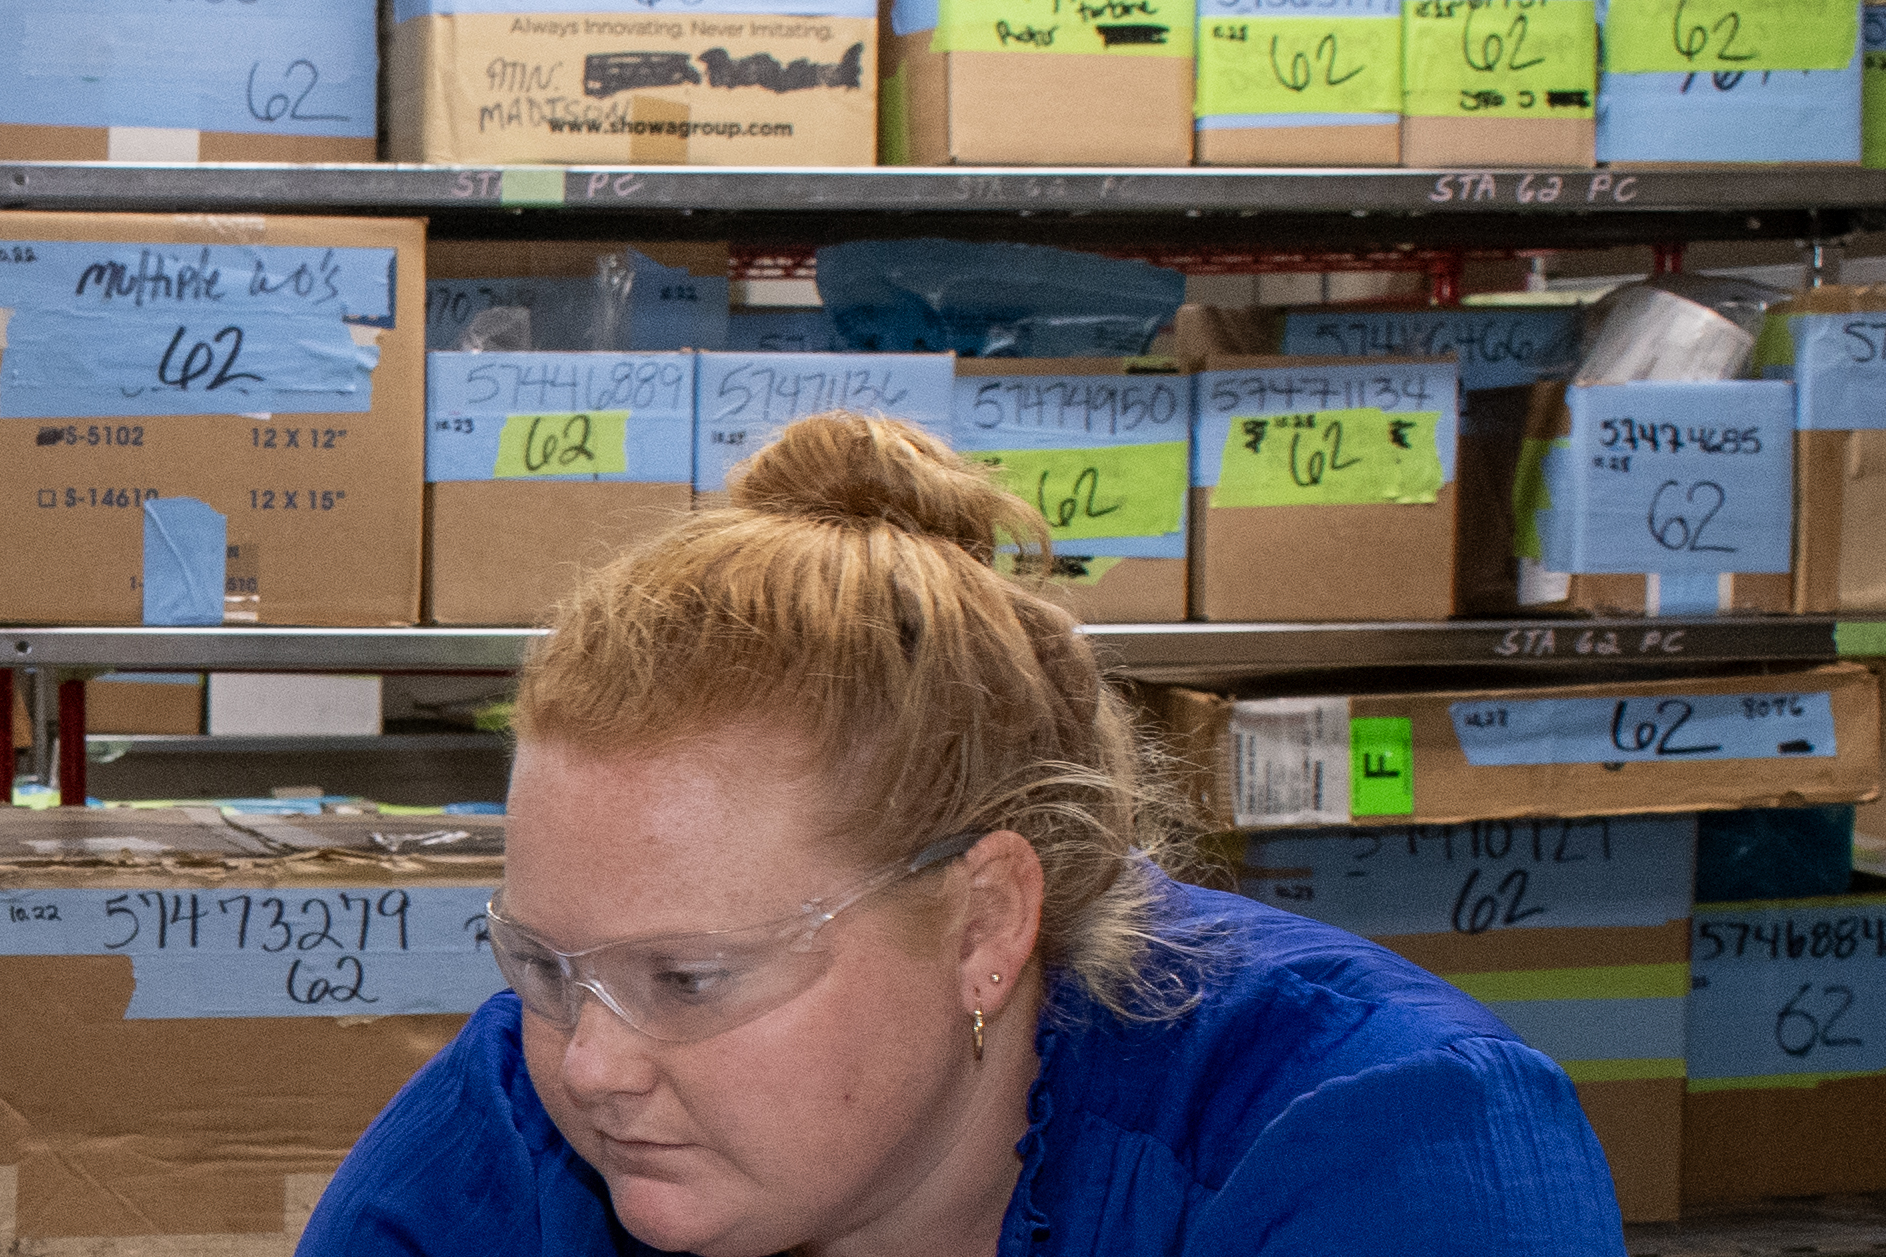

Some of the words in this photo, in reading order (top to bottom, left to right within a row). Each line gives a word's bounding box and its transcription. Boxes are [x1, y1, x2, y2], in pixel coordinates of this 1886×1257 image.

[510, 19, 579, 38] Always
[584, 20, 684, 39] Innovating.
[691, 22, 745, 38] Never
[751, 23, 834, 41] Imitating.
[1464, 8, 1546, 72] 62
[1673, 0, 1759, 62] 62
[246, 58, 350, 122] 62
[1269, 33, 1366, 91] 62
[547, 116, 794, 139] www.showagroup.com
[1431, 176, 1498, 202] STA
[1589, 177, 1639, 201] PC
[158, 326, 265, 391] 62
[252, 427, 279, 449] 12
[525, 413, 596, 472] 62
[1289, 420, 1362, 487] 62
[250, 489, 277, 511] 12
[1038, 466, 1127, 528] 62
[1646, 479, 1737, 552] 62
[1493, 630, 1557, 657] STA
[1639, 630, 1686, 654] PC
[1612, 700, 1723, 754] 62
[1365, 753, 1400, 778] F
[9, 904, 62, 923] 10.22
[102, 888, 412, 952] 57473279
[1452, 869, 1544, 935] 62
[286, 955, 380, 1004] 62
[1775, 982, 1863, 1058] 62
